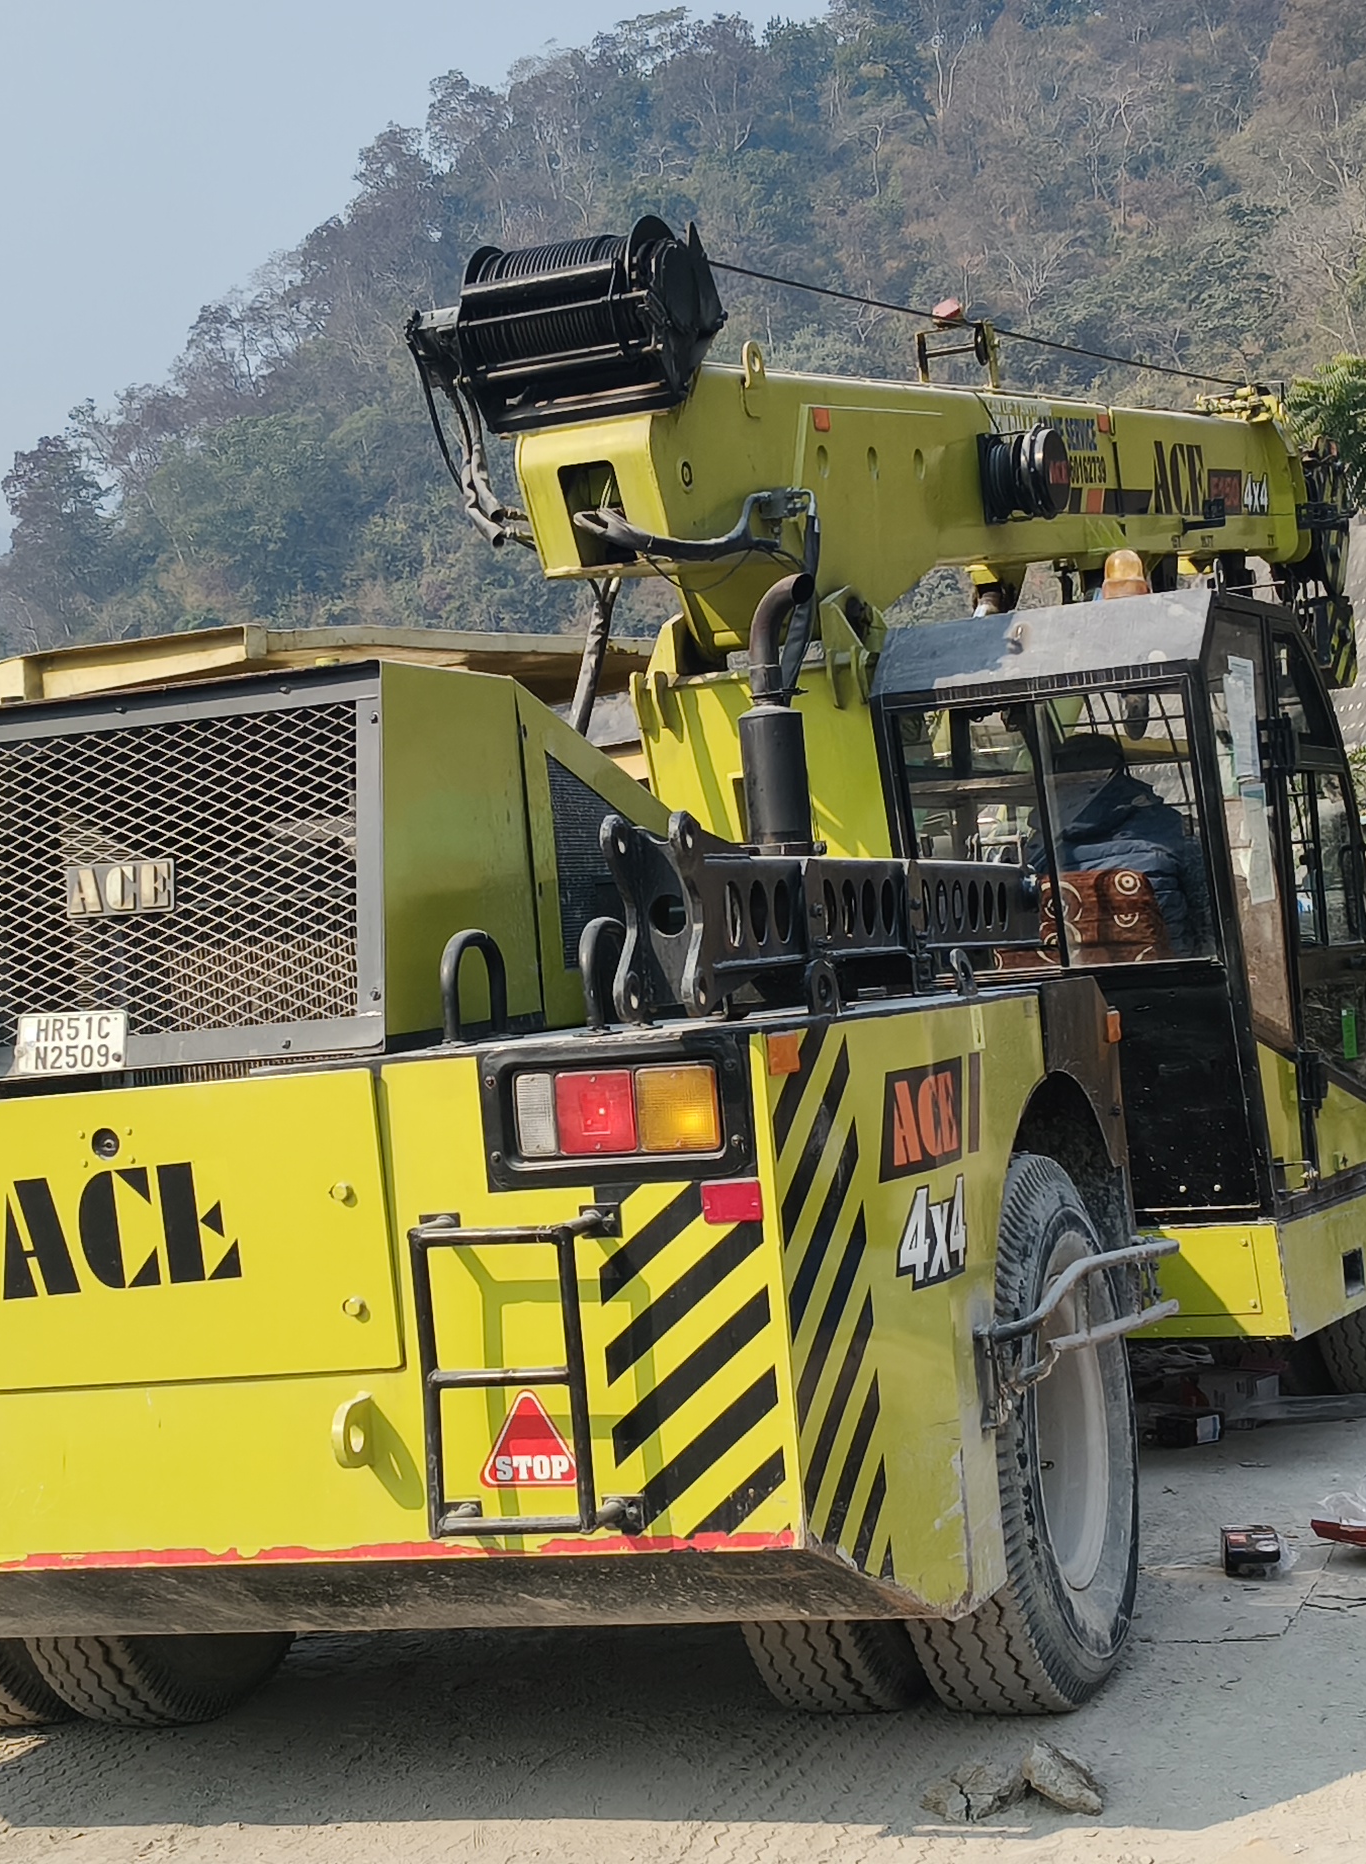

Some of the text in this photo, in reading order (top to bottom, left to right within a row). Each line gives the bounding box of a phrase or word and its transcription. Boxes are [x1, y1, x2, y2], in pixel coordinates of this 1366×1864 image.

[1154, 440, 1205, 515] ACE
[1244, 472, 1269, 513] 4x4
[70, 862, 170, 915] ACE
[34, 1044, 109, 1070] N2509
[36, 1016, 111, 1043] HR51C
[893, 1071, 959, 1167] ACE
[3, 1161, 242, 1301] ACE
[898, 1174, 967, 1283] 4x4
[495, 1455, 569, 1480] STOP
